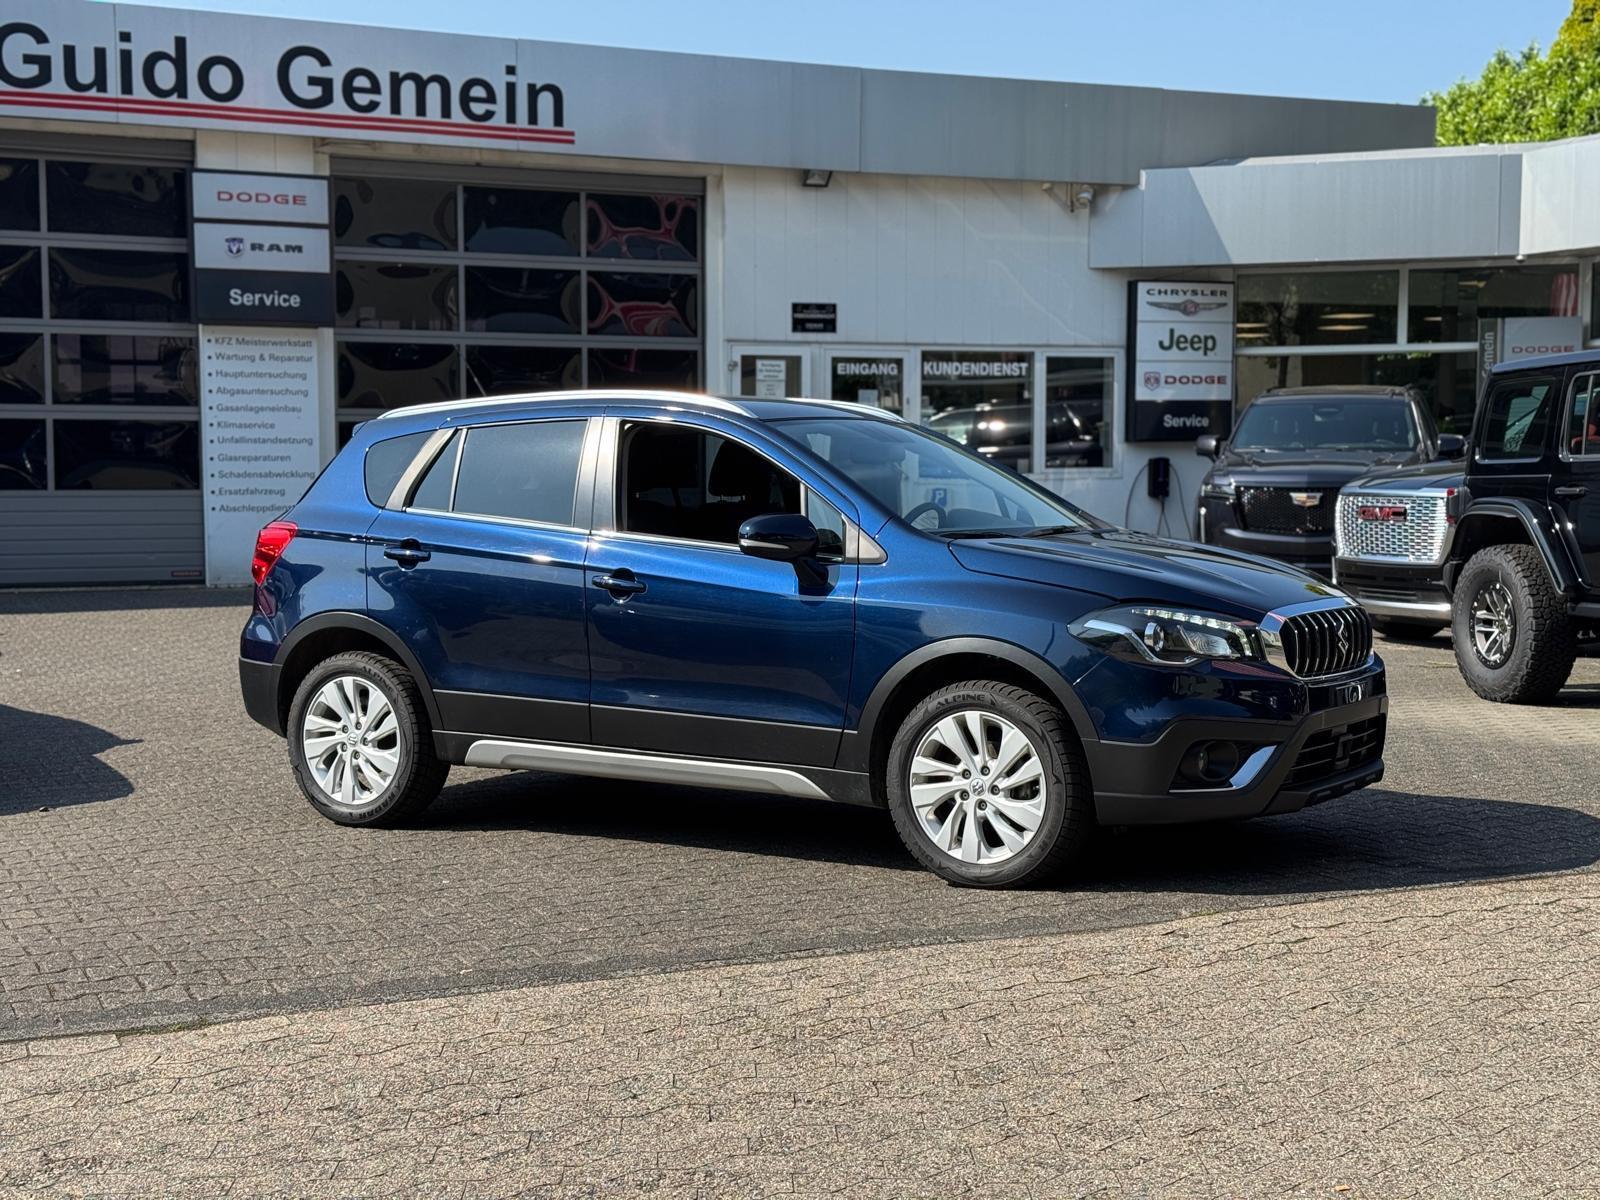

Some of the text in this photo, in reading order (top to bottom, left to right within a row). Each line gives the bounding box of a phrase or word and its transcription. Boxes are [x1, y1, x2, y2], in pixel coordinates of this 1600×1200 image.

[0, 22, 564, 128] Guido Gemein
[216, 190, 307, 206] DODGE
[250, 242, 304, 254] RAM
[228, 288, 301, 307] Service
[1146, 288, 1228, 298] CHRYSLER
[214, 336, 312, 347] KFZ Meisterwerkstatt
[1158, 328, 1216, 356] Jeep
[1512, 345, 1575, 353] DODGE
[214, 352, 312, 363] Wartung & Reparatur
[837, 363, 899, 376] EINGANG
[923, 361, 1029, 377] KUNDENDIENST
[215, 369, 308, 381] Hauptuntersuchung
[1164, 375, 1227, 385] DODGE
[216, 386, 309, 398] Abgasuntersuchung
[216, 403, 302, 414] Gasanlageneinbau
[217, 421, 276, 430] Klimaservice
[1163, 414, 1209, 428] Service
[217, 436, 313, 446] Unfallinstandsetzung
[217, 453, 291, 464] Glasreparaturen
[218, 470, 316, 480] Schadensabwicklung
[218, 488, 286, 497] Ersatzfahrzeug
[219, 504, 294, 513] Abschleppdien
[1359, 506, 1405, 521] GMC
[935, 693, 986, 710] ALPINE
